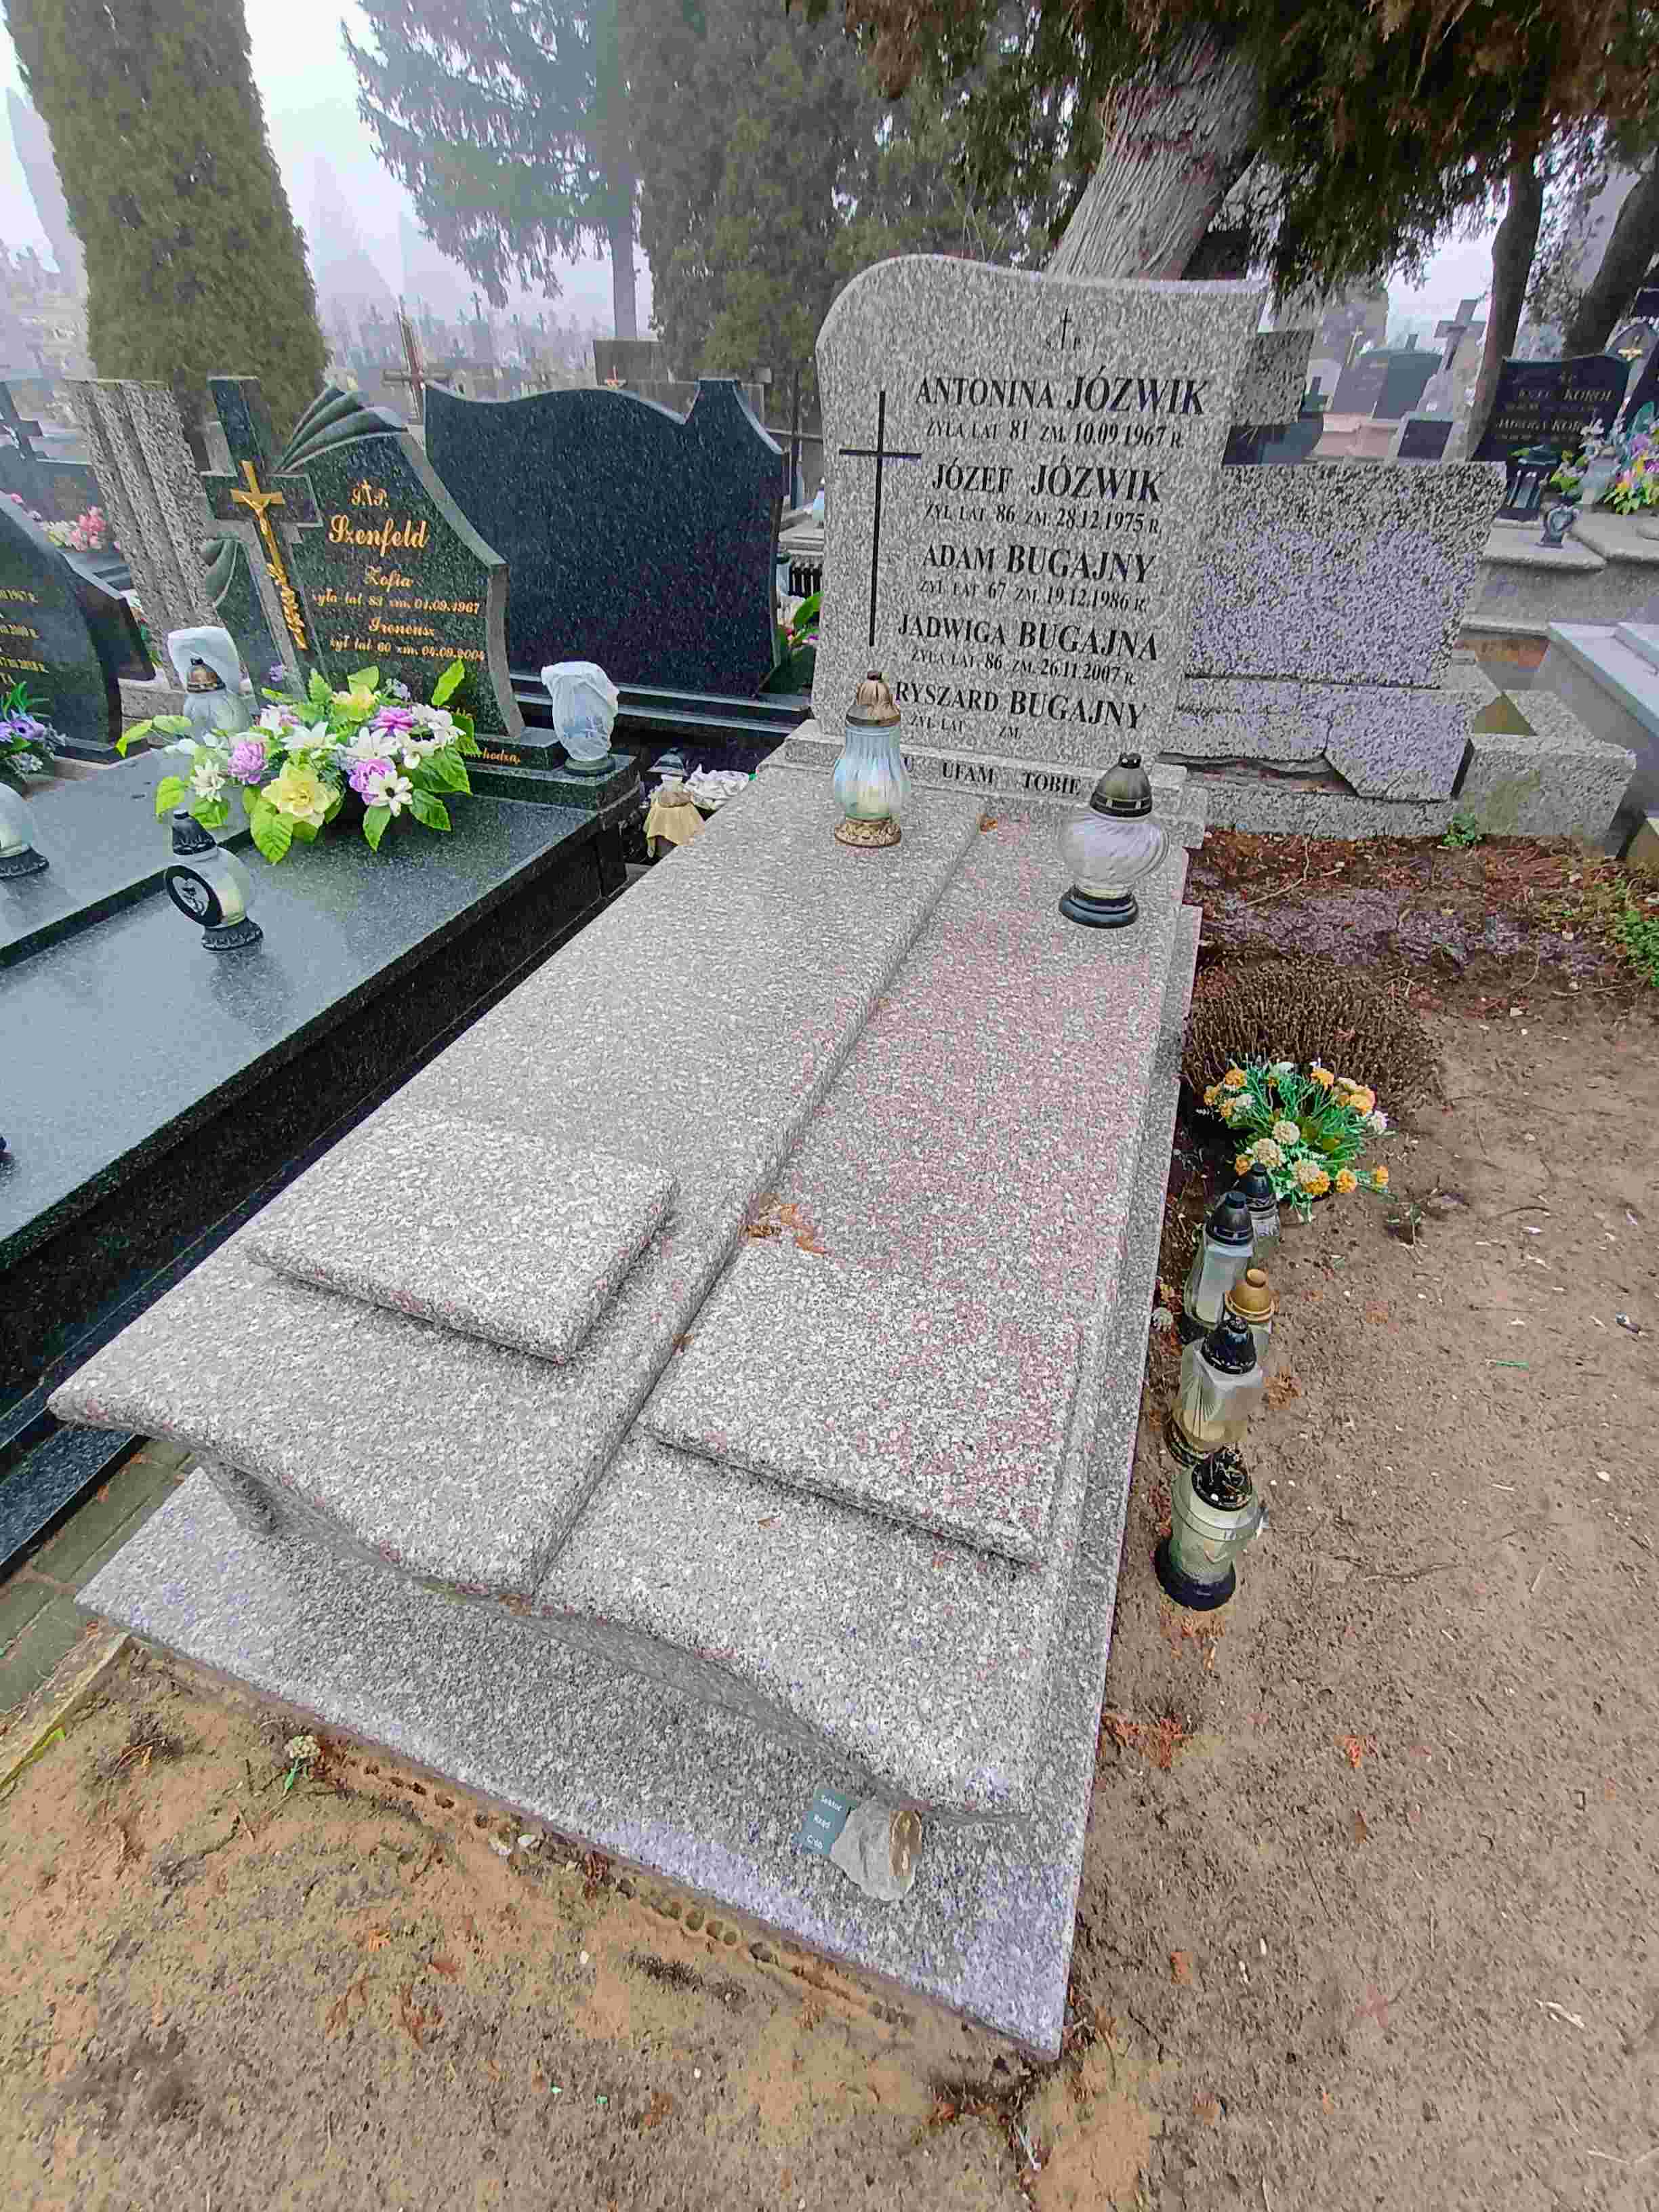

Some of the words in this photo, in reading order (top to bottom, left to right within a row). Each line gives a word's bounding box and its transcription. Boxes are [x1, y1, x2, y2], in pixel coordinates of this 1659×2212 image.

[916, 377, 1054, 409] ANTONINA
[971, 420, 998, 440] LAT
[1009, 419, 1029, 440] 81
[1073, 422, 1166, 447] 10.09.1967
[932, 457, 1013, 493] JÓZEF
[996, 504, 1016, 524] 86
[1056, 508, 1145, 533] 28.12.1975
[329, 515, 430, 557] Szenfeld
[922, 544, 995, 573] ADAM
[1006, 545, 1155, 583] BUGAJNY
[987, 581, 1006, 600] 67
[1046, 585, 1129, 611] 19.12.1986
[898, 613, 1006, 647] JADWIGA
[1018, 621, 1157, 661] BUGAJNA
[985, 653, 1002, 671] 86
[1040, 658, 1120, 684] 26.11.2007
[896, 681, 999, 712] RYSZARD
[1010, 691, 1147, 730] BUGAJNY
[942, 764, 994, 784] UFAM
[1023, 773, 1080, 796] TOBIE
